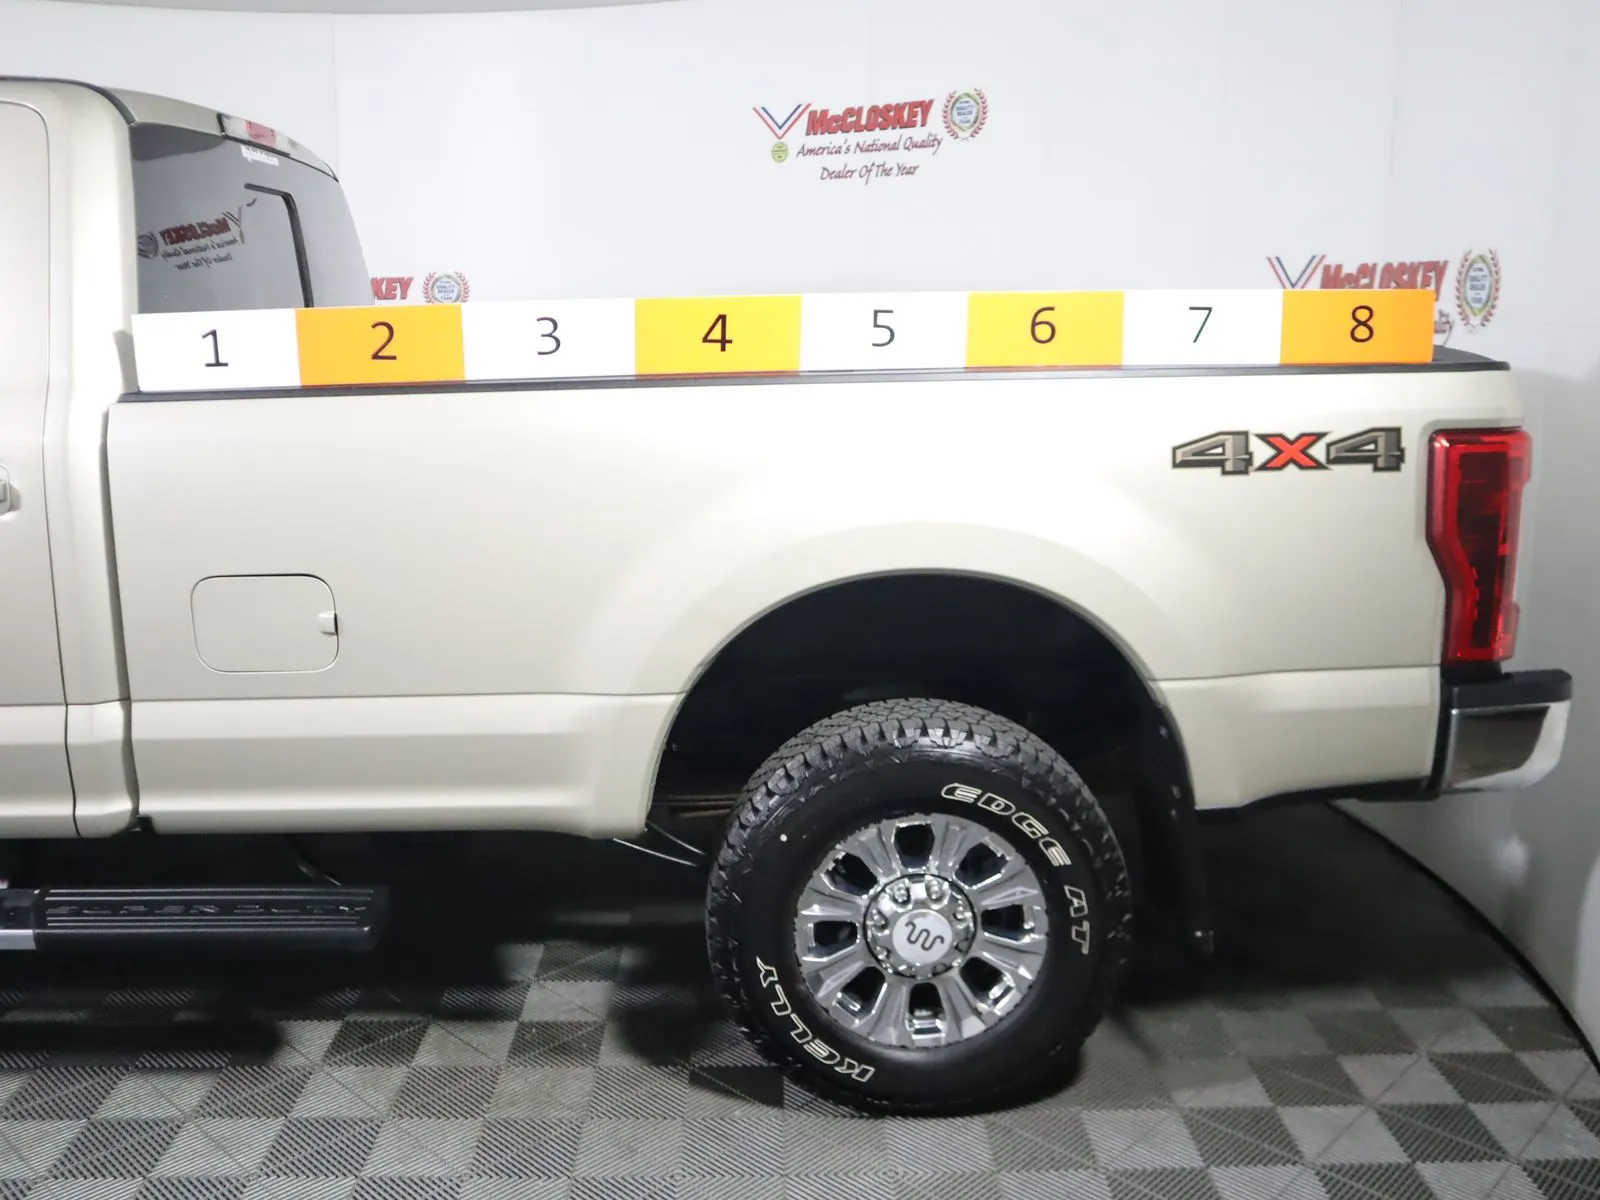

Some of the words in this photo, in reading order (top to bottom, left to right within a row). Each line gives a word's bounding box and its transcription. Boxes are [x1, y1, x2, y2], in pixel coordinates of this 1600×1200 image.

[805, 99, 935, 136] McCLOSKEY
[796, 138, 851, 158] America's
[854, 134, 902, 154] National
[903, 132, 943, 156] Quality
[820, 163, 856, 180] Dealer
[859, 160, 875, 185] Of
[874, 161, 893, 177] The
[895, 160, 919, 177] Year
[202, 330, 229, 367] 1
[370, 322, 398, 361] 2
[536, 317, 561, 355] 3
[702, 313, 733, 352] 4
[871, 310, 896, 347] 5
[1030, 306, 1056, 344] 6
[1189, 307, 1213, 344] 7
[1350, 304, 1375, 343] 8
[940, 782, 1072, 868] EDGE
[1064, 883, 1091, 956] AT
[755, 955, 876, 1083] KELLY
